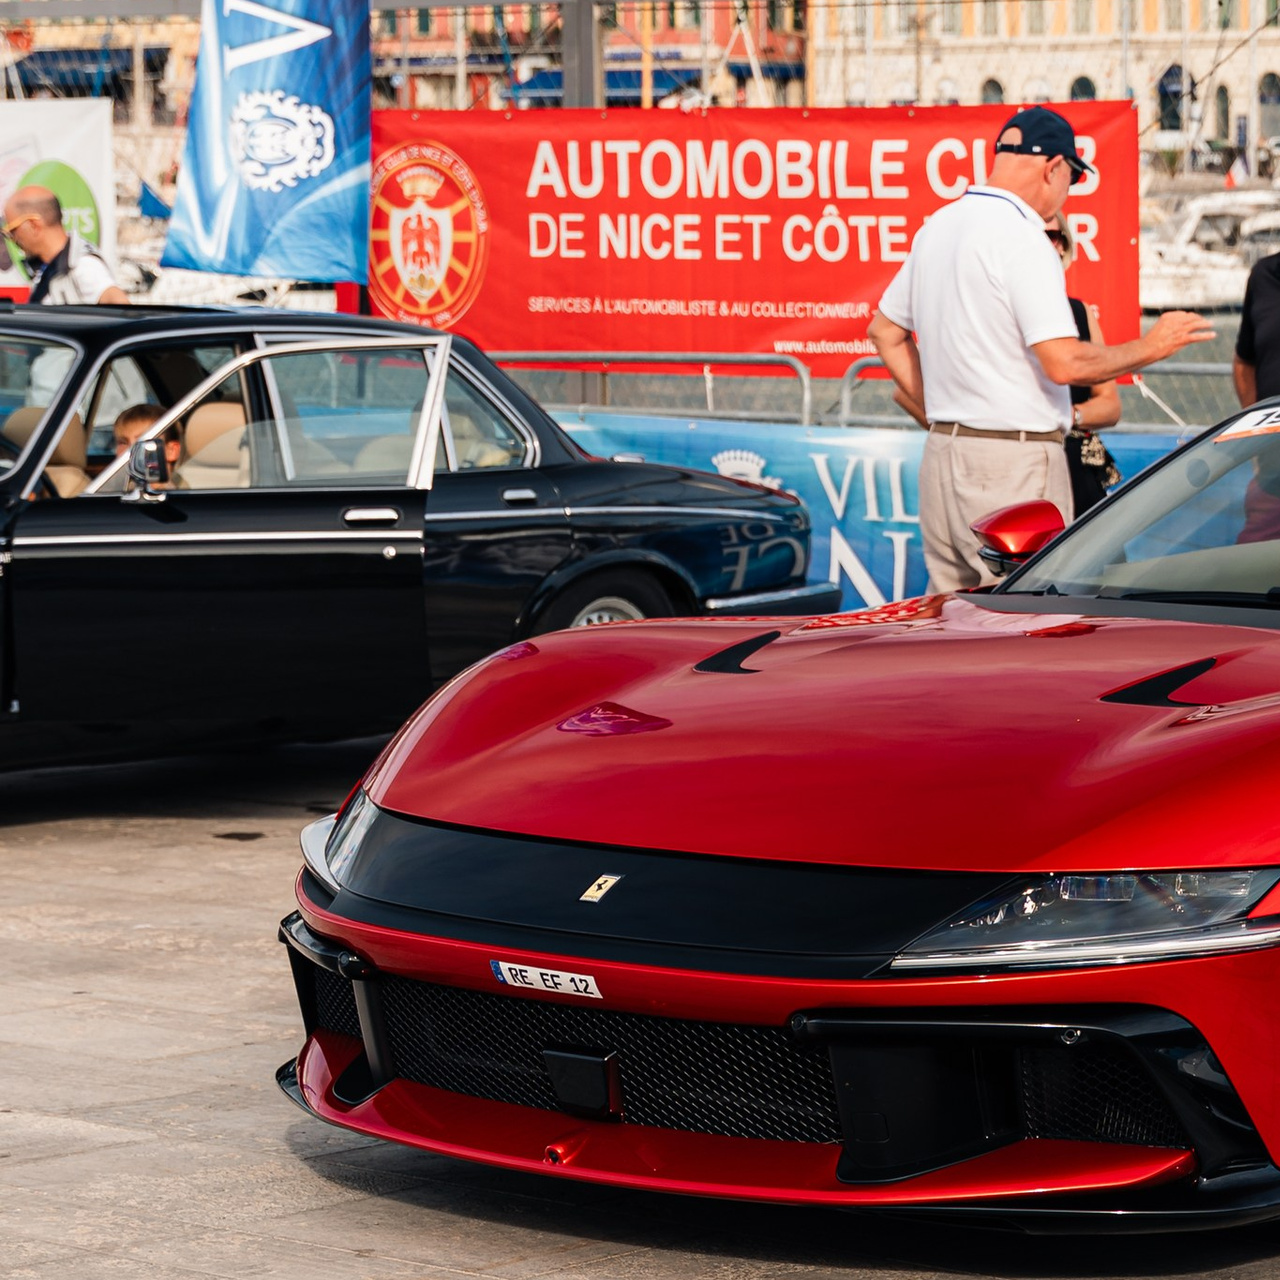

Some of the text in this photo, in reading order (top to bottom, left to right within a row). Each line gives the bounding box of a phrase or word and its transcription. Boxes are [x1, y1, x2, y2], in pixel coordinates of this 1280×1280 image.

[526, 136, 1101, 199] AUTOMOBILE CLB
[528, 203, 910, 262] DE NICE ET CÔTE
[528, 296, 591, 314] SERVICES
[604, 298, 717, 317] L'AUTOMOBILISTE
[730, 301, 750, 318] AU
[751, 301, 869, 319] COLLECTIONNEUR
[773, 339, 878, 355] www.automobile
[507, 966, 595, 995] RE EF 12
